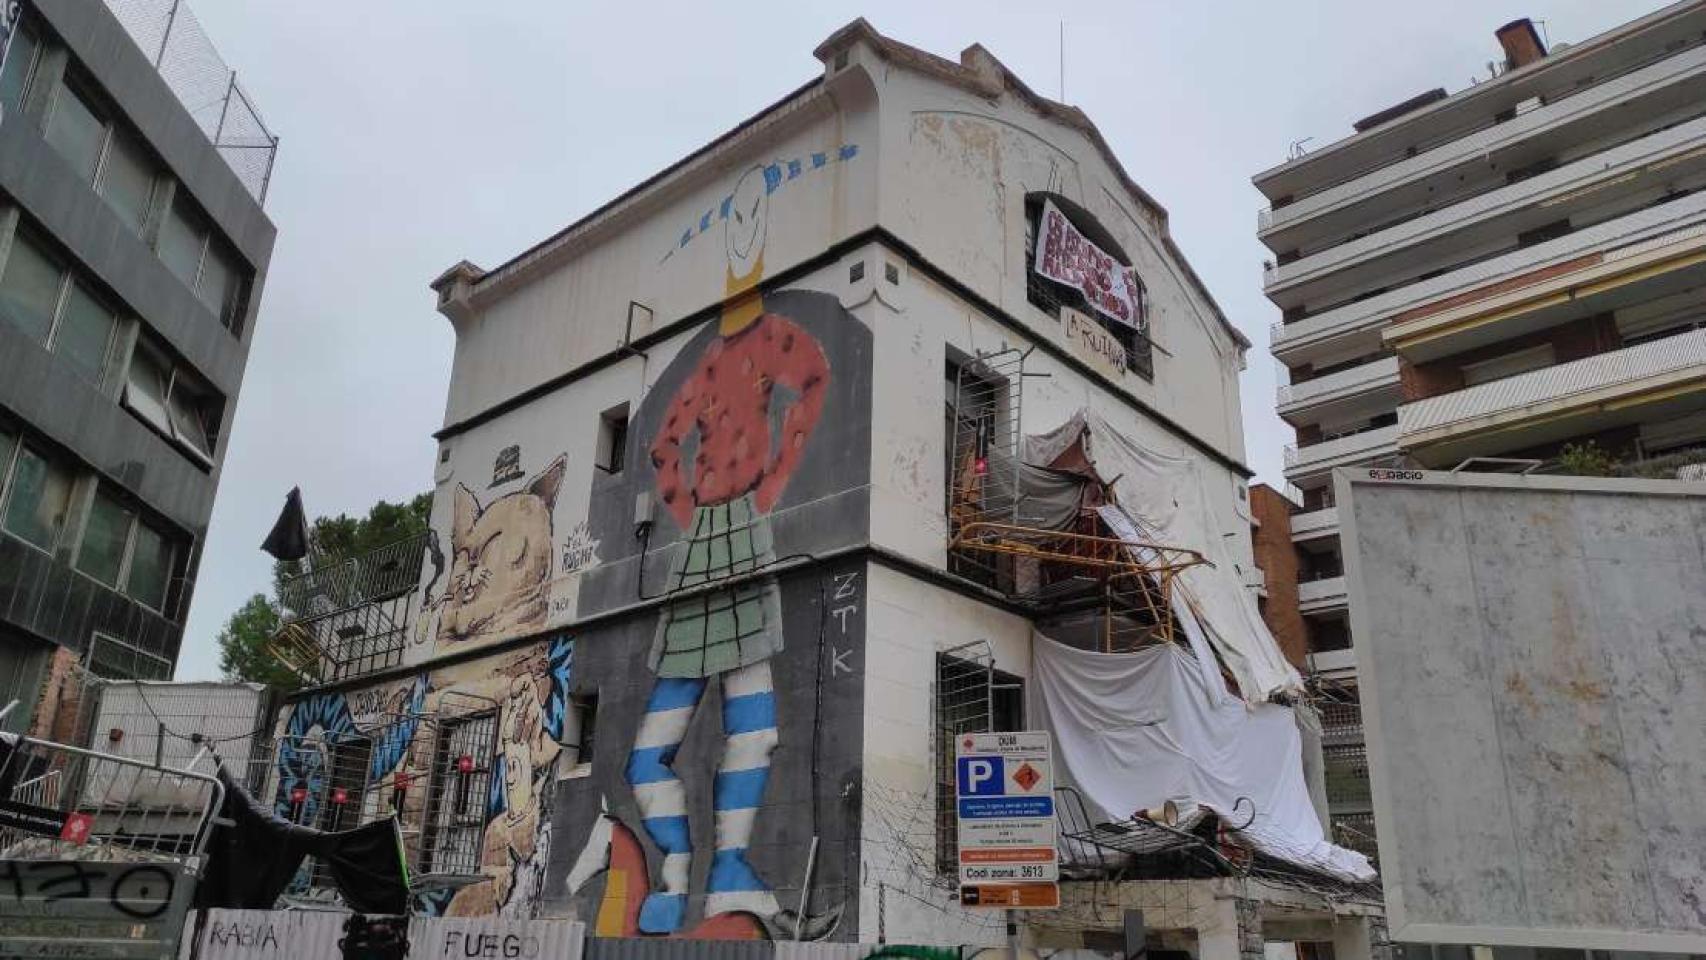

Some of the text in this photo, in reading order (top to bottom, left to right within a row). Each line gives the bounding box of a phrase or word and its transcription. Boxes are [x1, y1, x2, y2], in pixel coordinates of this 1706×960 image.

[968, 761, 992, 793] P
[966, 867, 989, 878] Codi
[1021, 866, 1043, 878] 3613
[210, 920, 279, 951] RABIA
